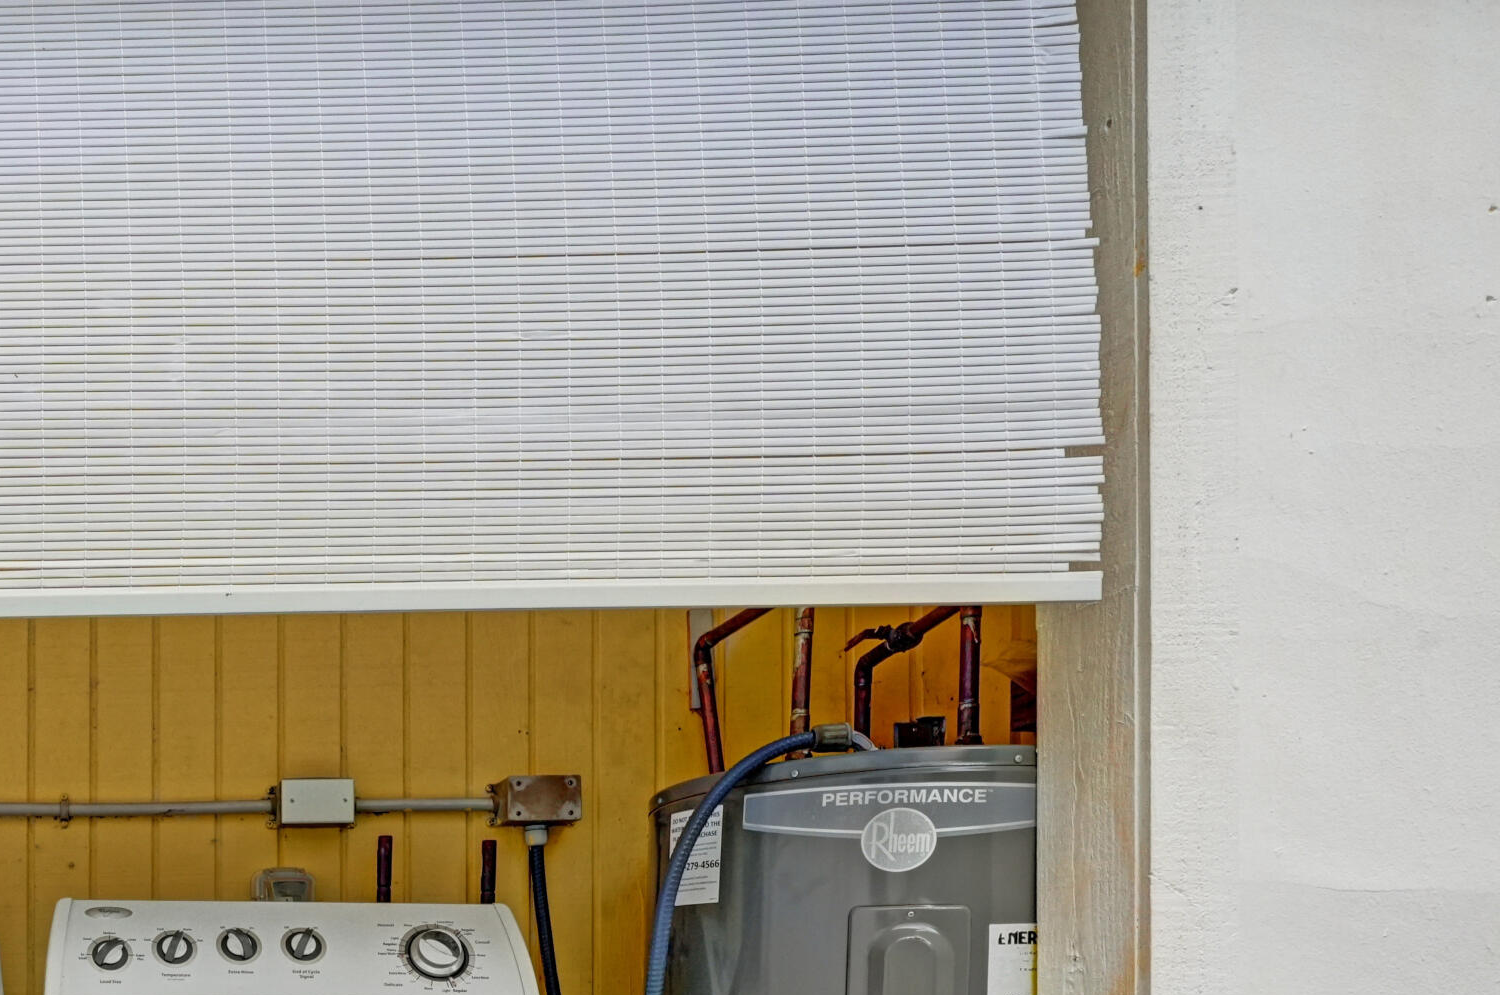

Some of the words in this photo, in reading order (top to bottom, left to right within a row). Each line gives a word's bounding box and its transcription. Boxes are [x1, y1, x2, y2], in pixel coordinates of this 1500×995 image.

[822, 788, 988, 807] PERFORMANCE
[711, 820, 721, 828] THE
[700, 829, 718, 838] CHASE
[870, 812, 931, 862] Rheem
[998, 930, 1038, 945] ENER
